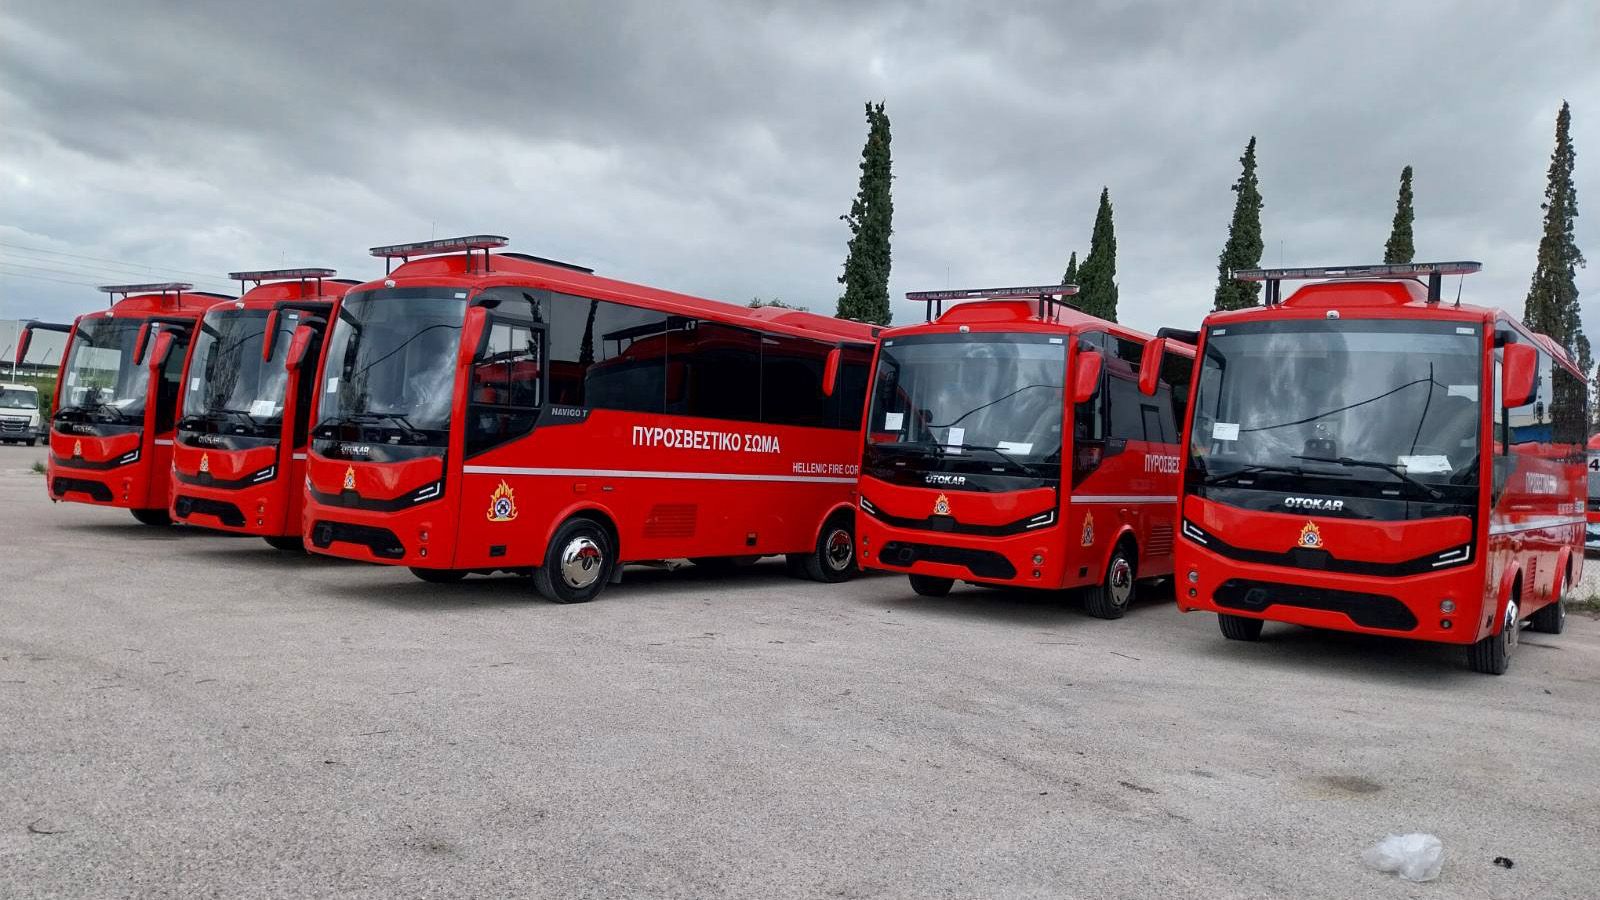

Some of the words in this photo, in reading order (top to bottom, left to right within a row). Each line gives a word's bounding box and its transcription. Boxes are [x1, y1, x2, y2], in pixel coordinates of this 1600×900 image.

[551, 407, 580, 417] NAVIGO
[582, 409, 588, 418] T
[632, 425, 741, 452] ΠΥΡΟΣΒΕΣΤΙΚΟ
[744, 434, 780, 454] ΣΩΜΑ
[792, 462, 827, 474] HELLENIC
[828, 463, 843, 474] FIRE
[925, 474, 966, 486] OTOKAR
[1284, 497, 1344, 511] OTOKAR
